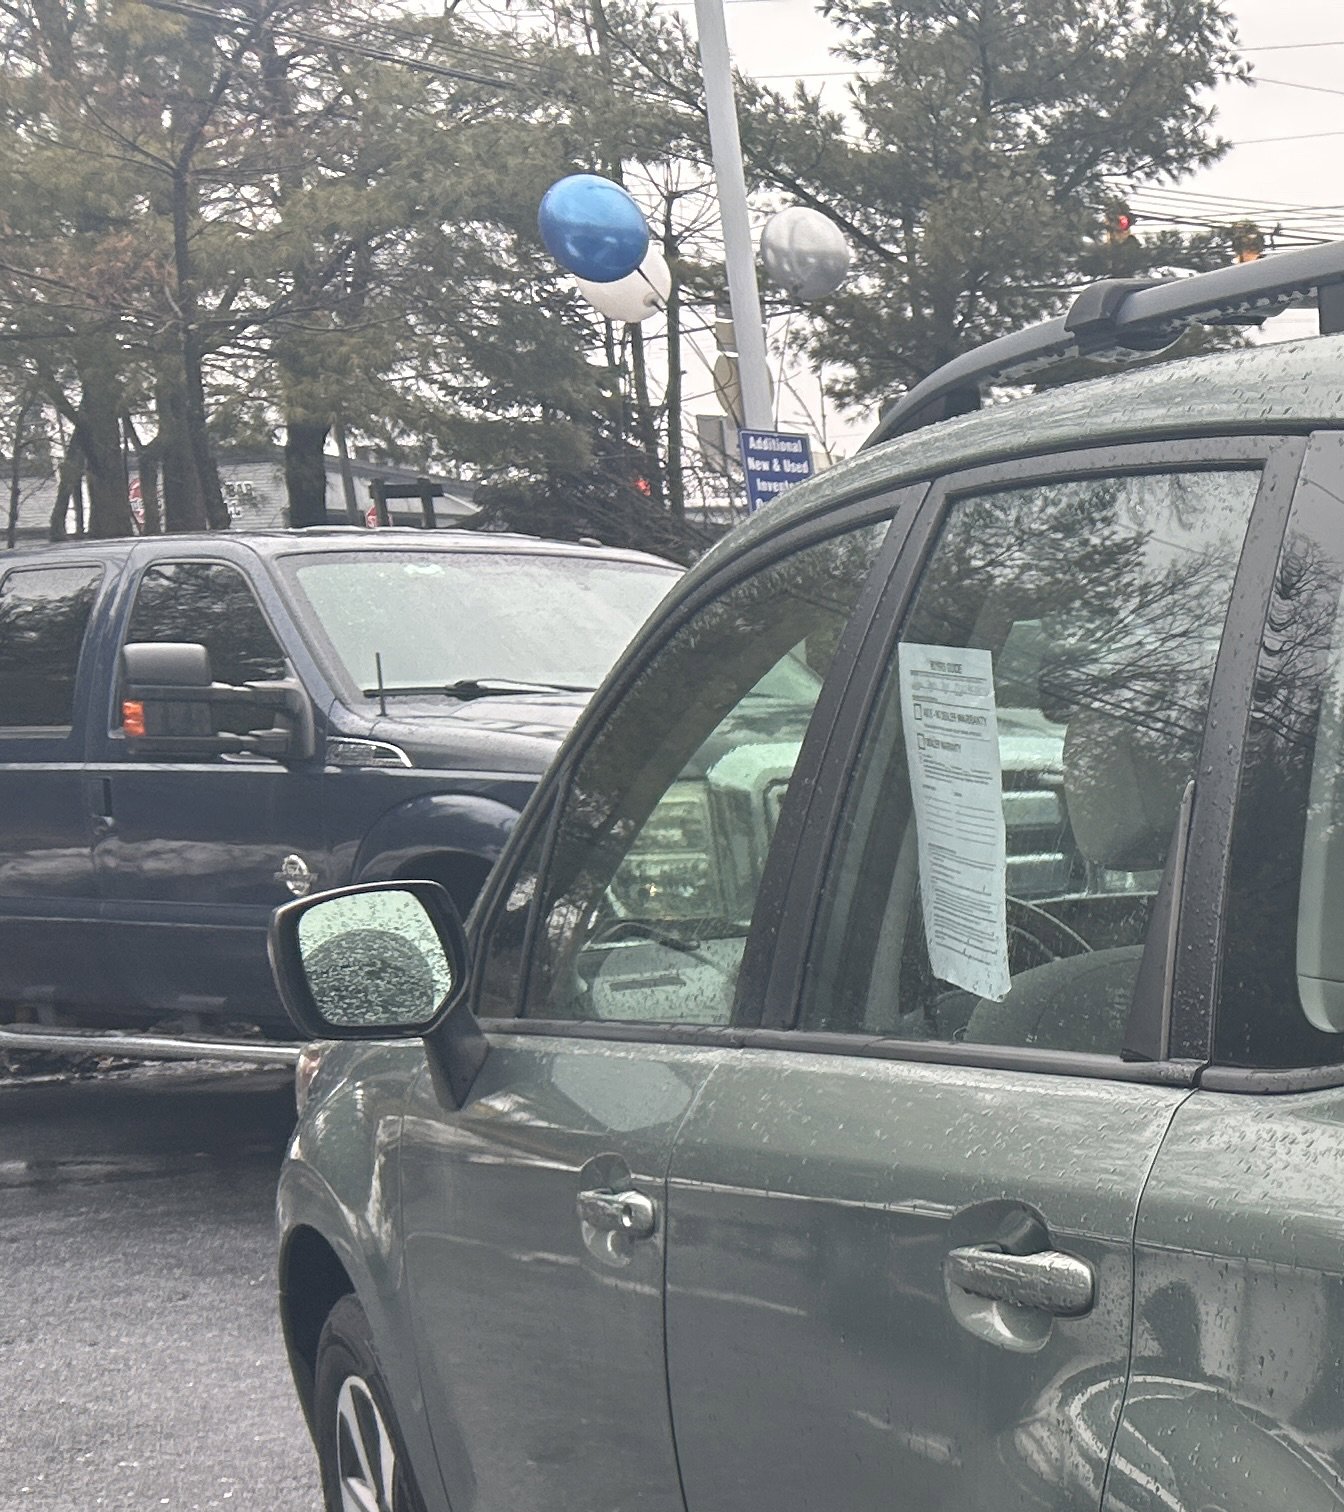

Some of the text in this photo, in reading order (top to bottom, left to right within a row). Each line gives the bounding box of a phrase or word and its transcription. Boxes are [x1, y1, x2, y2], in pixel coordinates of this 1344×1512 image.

[749, 436, 803, 453] Additional
[747, 457, 809, 474] New & Used
[756, 478, 800, 492] Invento
